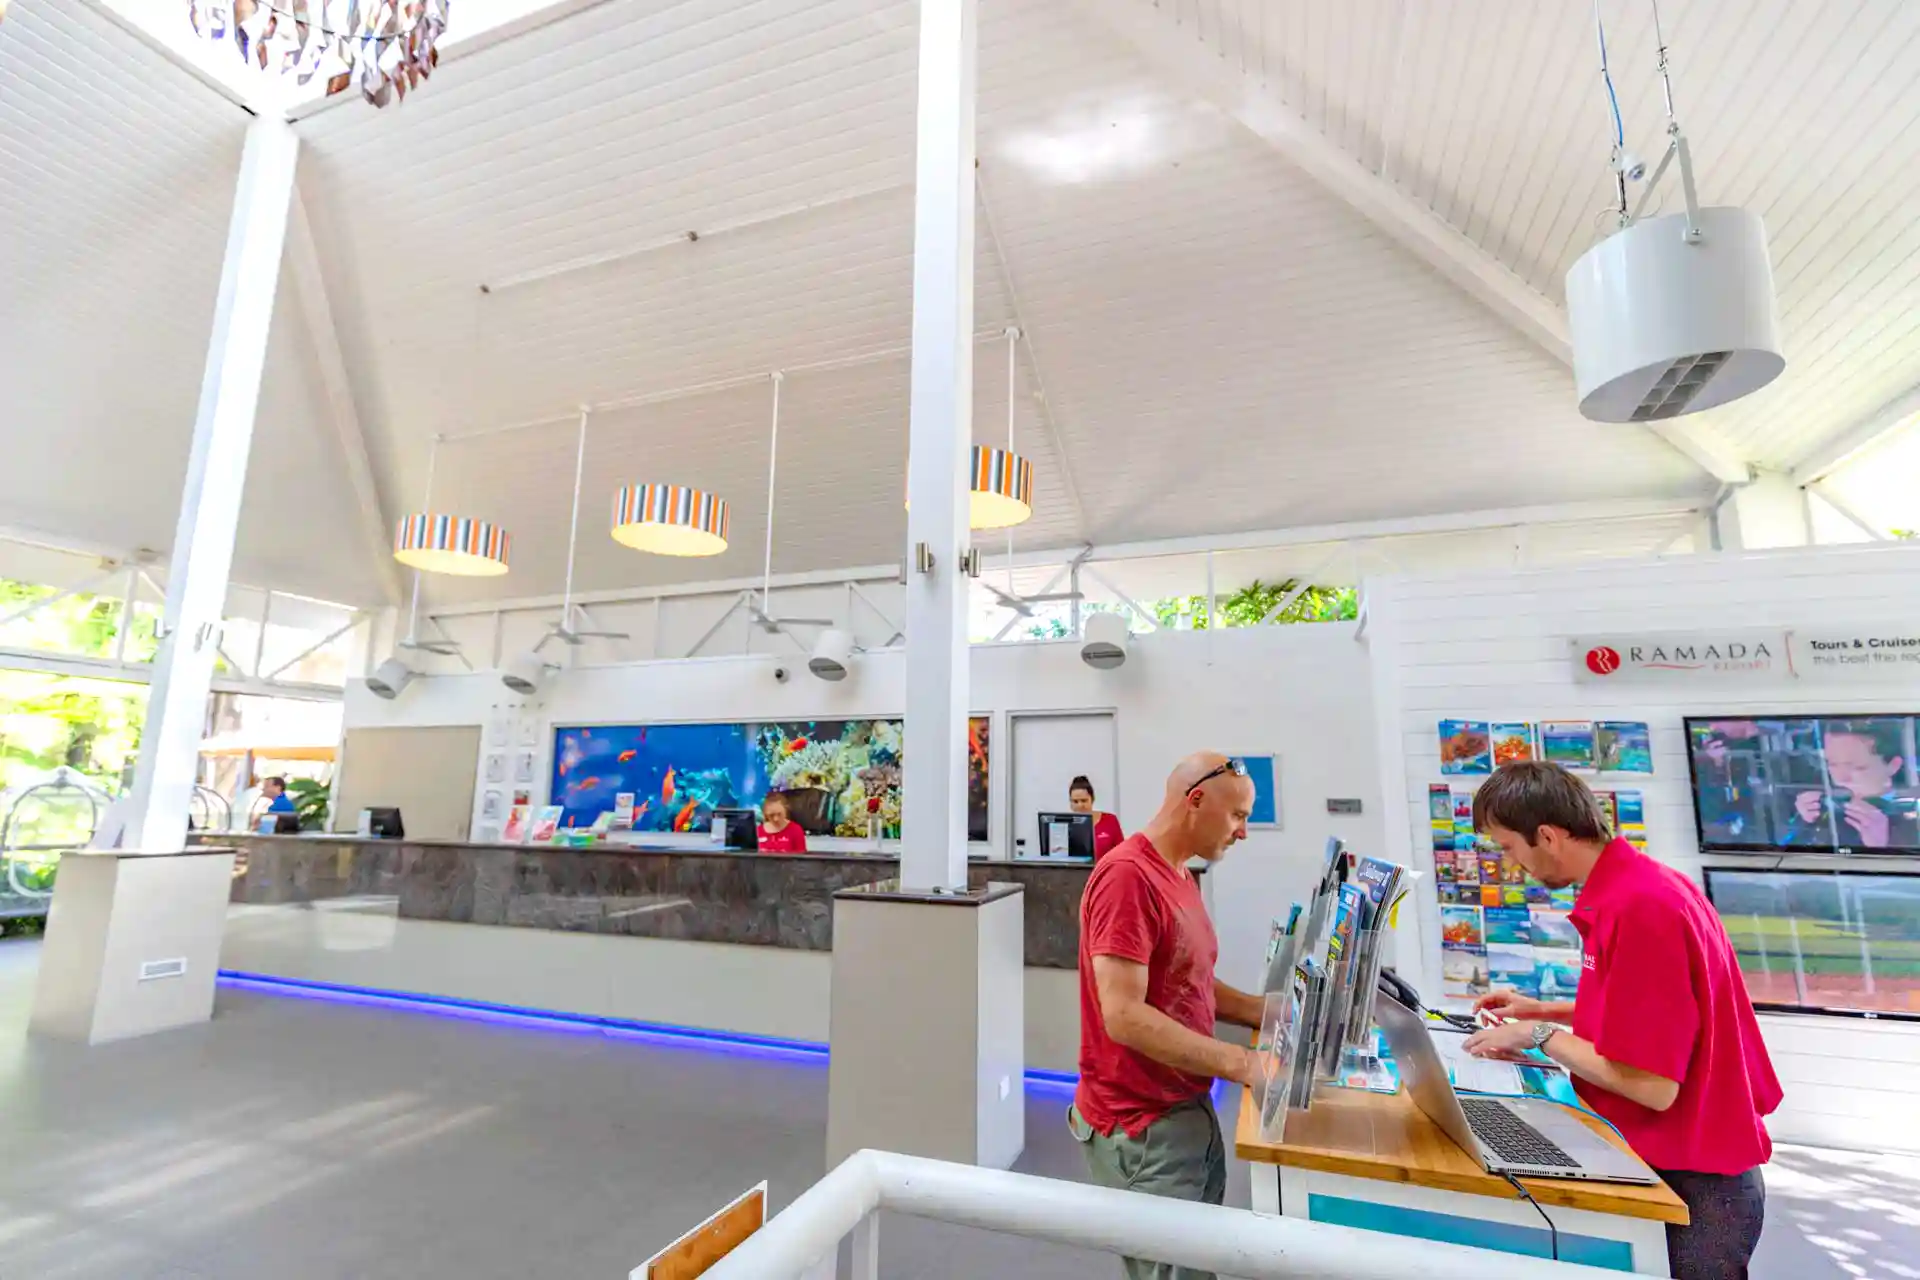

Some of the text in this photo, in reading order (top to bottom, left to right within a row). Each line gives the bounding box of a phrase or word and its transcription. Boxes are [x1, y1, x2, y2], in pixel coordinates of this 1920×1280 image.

[1810, 637, 1920, 650] Tours & Cruise
[1630, 642, 1772, 662] RAMADA
